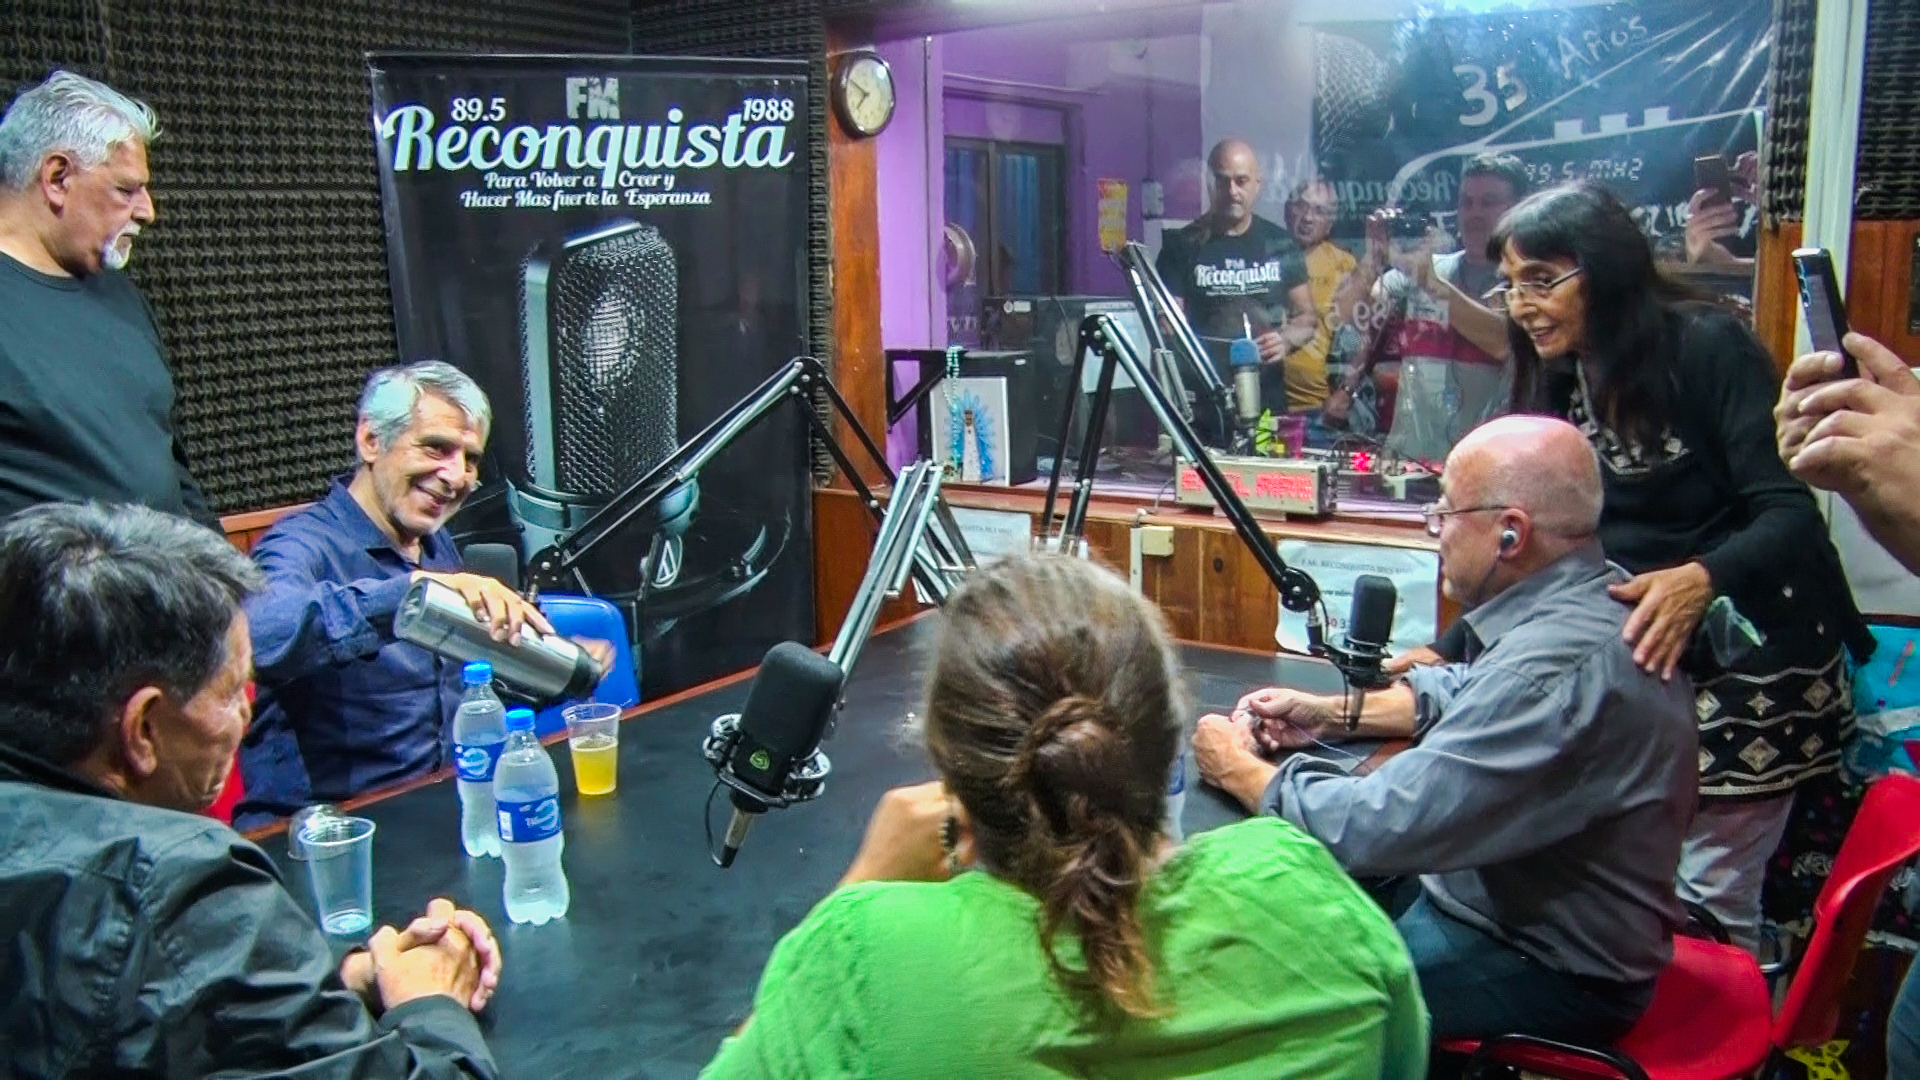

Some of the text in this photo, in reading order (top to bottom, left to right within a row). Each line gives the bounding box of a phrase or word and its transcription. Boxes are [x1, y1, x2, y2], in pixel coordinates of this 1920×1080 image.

[450, 97, 506, 122] 89.5
[566, 77, 620, 120] FM
[743, 97, 795, 122] 1988
[382, 105, 795, 189] Reconquista
[484, 170, 675, 191] Para Volver a Creer y
[460, 189, 712, 211] Hacer Mas fuerte la Esperanza
[1194, 261, 1281, 291] Reconquista
